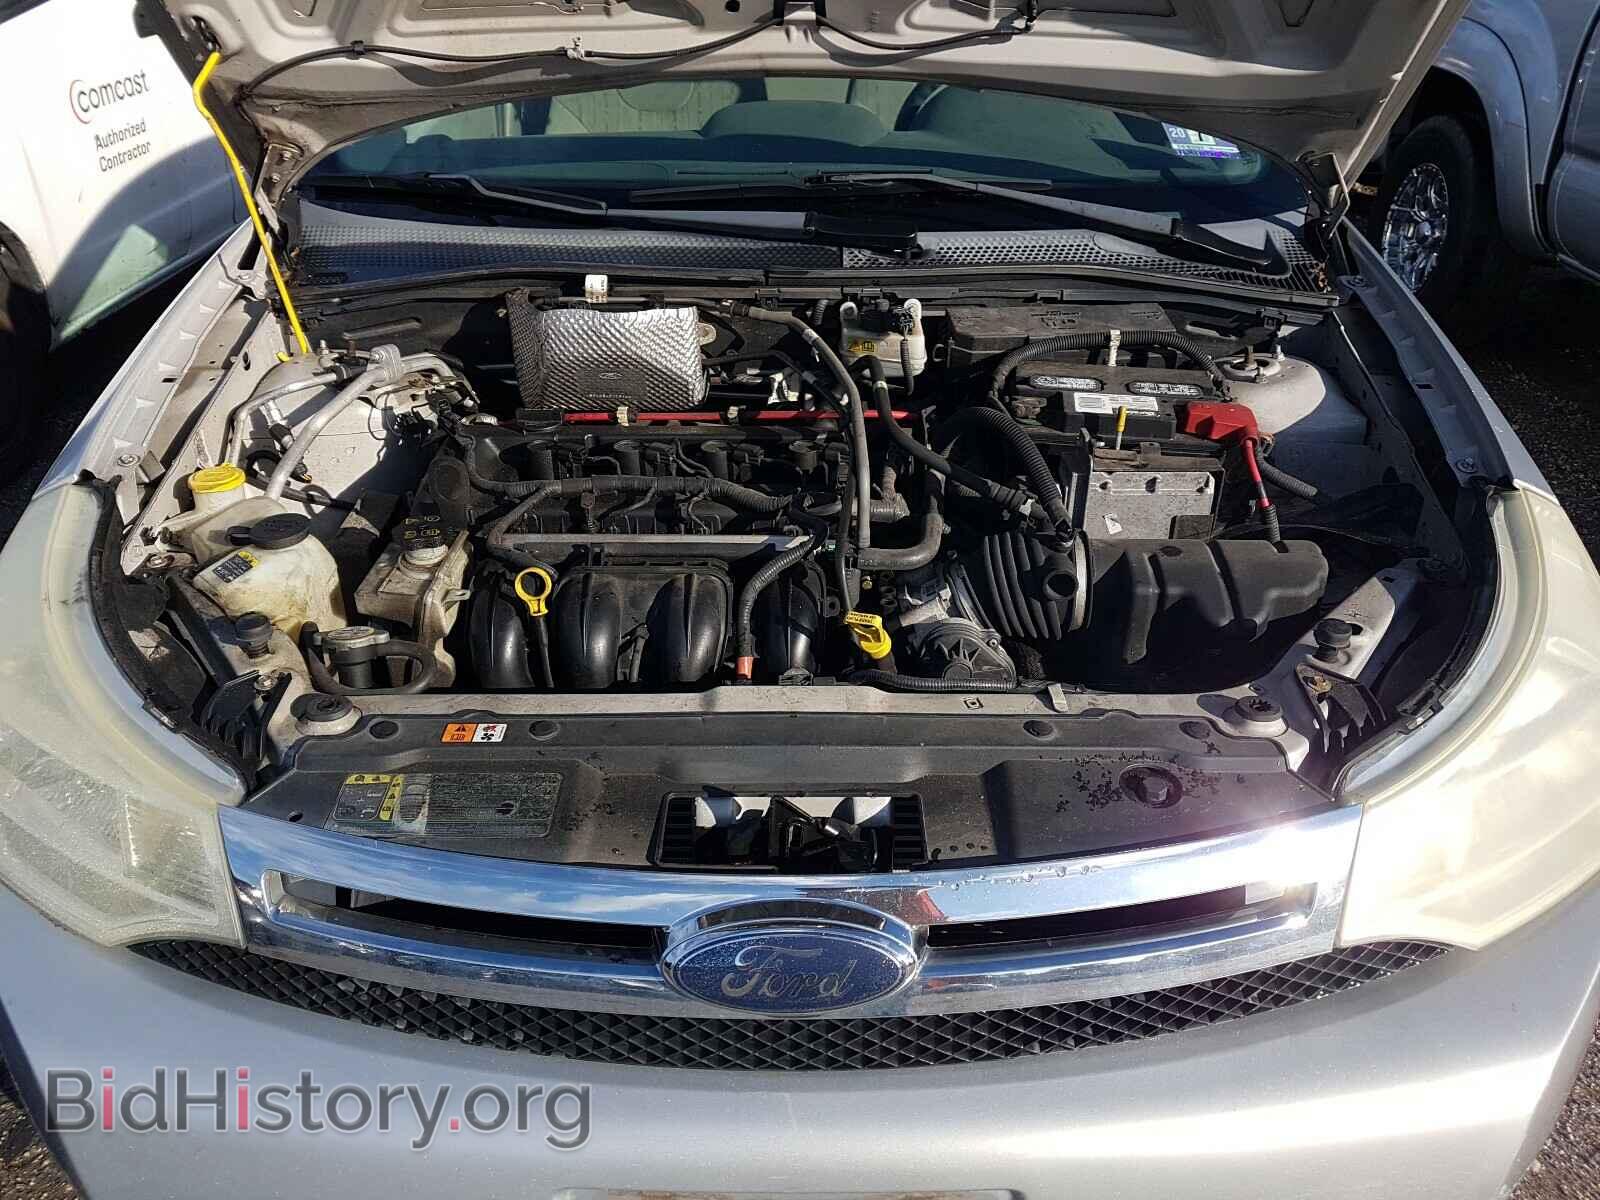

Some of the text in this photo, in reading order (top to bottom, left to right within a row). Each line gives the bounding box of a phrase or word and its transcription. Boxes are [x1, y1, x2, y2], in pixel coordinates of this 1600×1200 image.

[95, 117, 147, 151] Authorized
[1168, 127, 1186, 138] 20
[99, 141, 151, 172] Contractor
[720, 945, 874, 998] Ford
